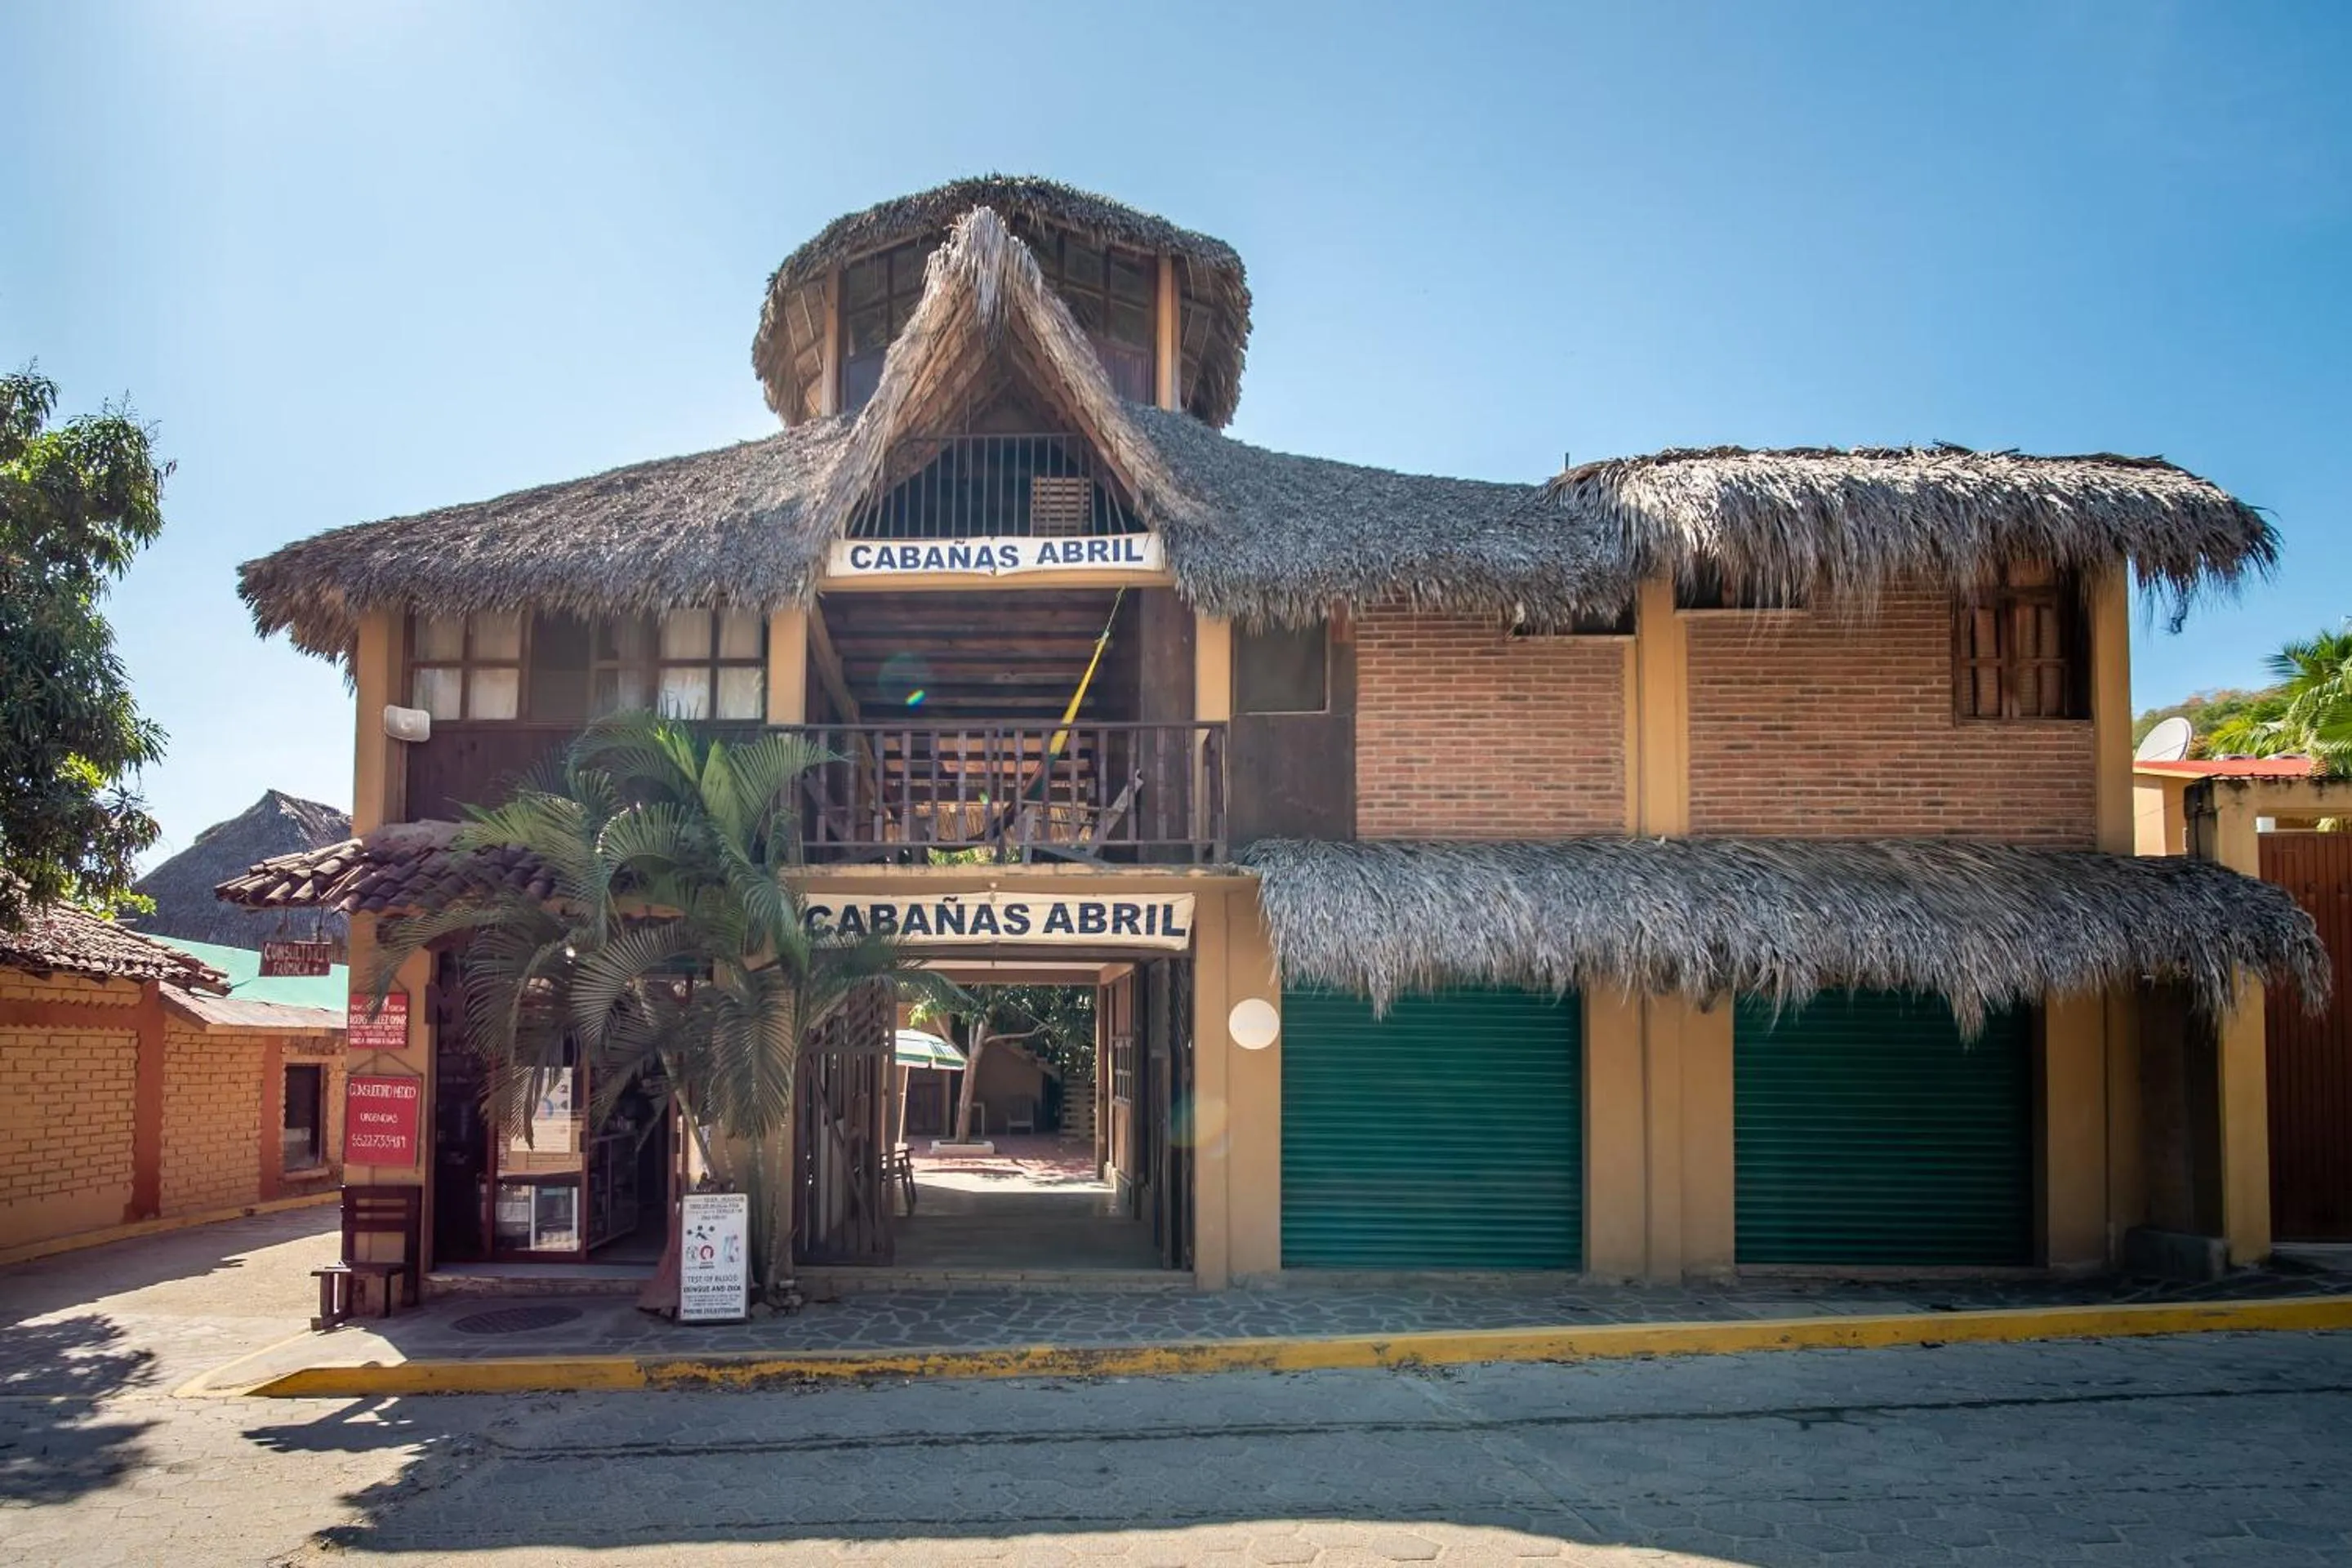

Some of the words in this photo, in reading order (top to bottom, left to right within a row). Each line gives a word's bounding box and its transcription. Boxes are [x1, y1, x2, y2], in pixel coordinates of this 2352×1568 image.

[850, 539, 1019, 569] CABAÑAS
[1036, 538, 1143, 564] ABRIL
[805, 897, 1031, 936] CABAÑAS
[1042, 902, 1187, 938] ABRIL
